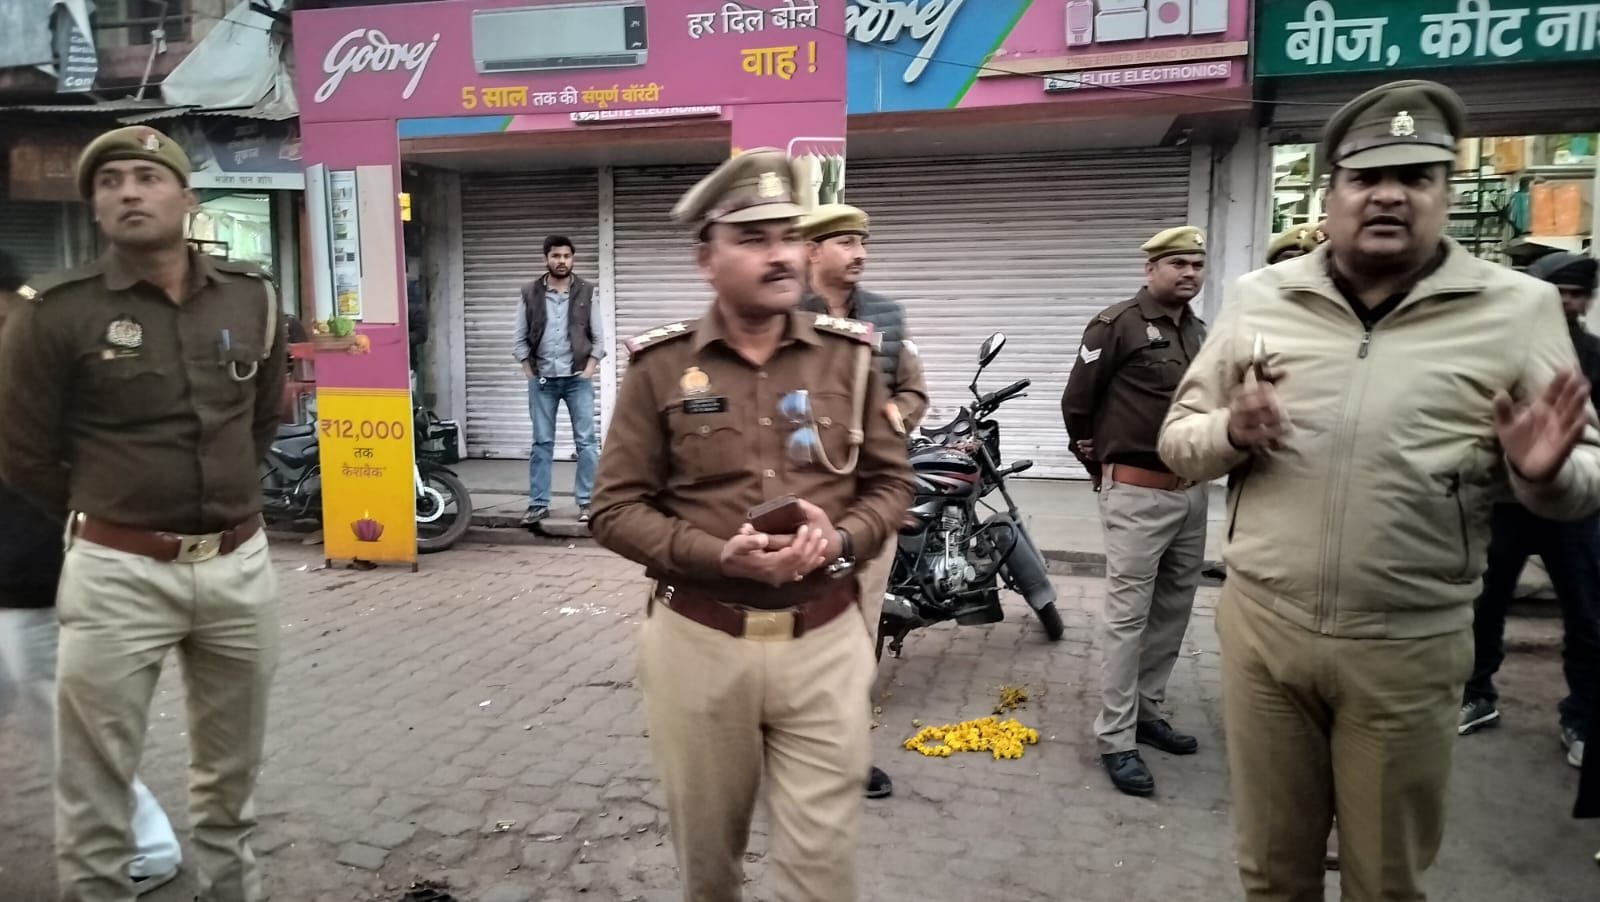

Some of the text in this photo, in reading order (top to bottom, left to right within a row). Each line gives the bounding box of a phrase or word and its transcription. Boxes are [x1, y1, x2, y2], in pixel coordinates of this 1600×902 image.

[686, 0, 819, 39] हर दिल बोले
[1286, 0, 1600, 66] बीज, कीट ना
[314, 28, 441, 103] Godrej
[1082, 63, 1228, 86] ELITE ELECTRONICS
[462, 87, 477, 110] 5
[481, 86, 529, 108] साल
[532, 91, 557, 106] तक
[559, 86, 578, 105] की
[581, 84, 619, 108] संपूर्ण
[320, 419, 404, 442] ₹12,000
[353, 447, 374, 459] तक
